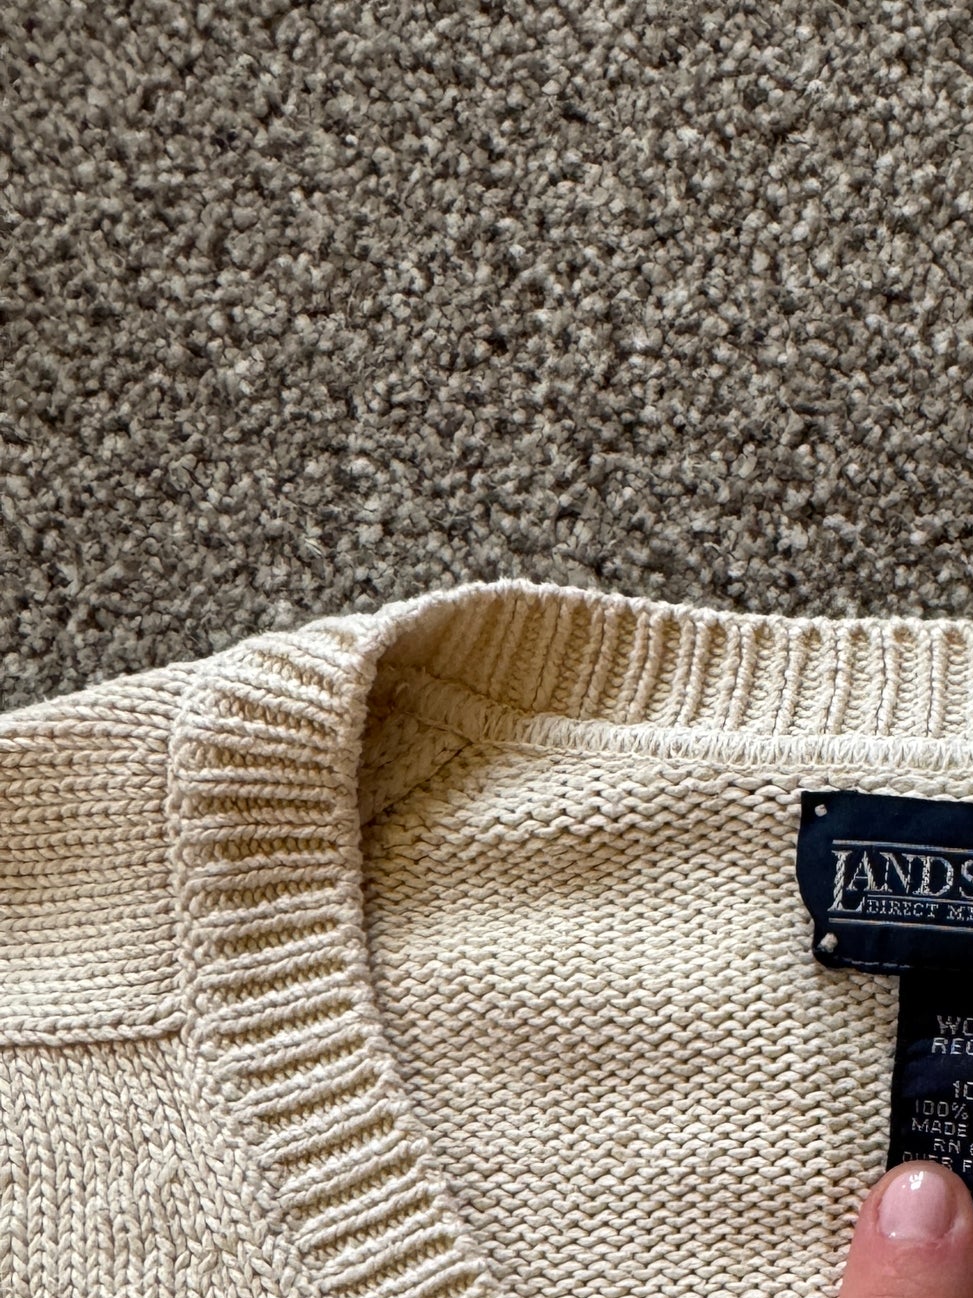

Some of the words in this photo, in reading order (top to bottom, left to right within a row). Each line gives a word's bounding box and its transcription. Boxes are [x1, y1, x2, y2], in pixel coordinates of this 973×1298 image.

[866, 899, 938, 919] DIRECT
[915, 1099, 969, 1120] 100%
[911, 1117, 967, 1137] MADE
[933, 1138, 960, 1154] RN
